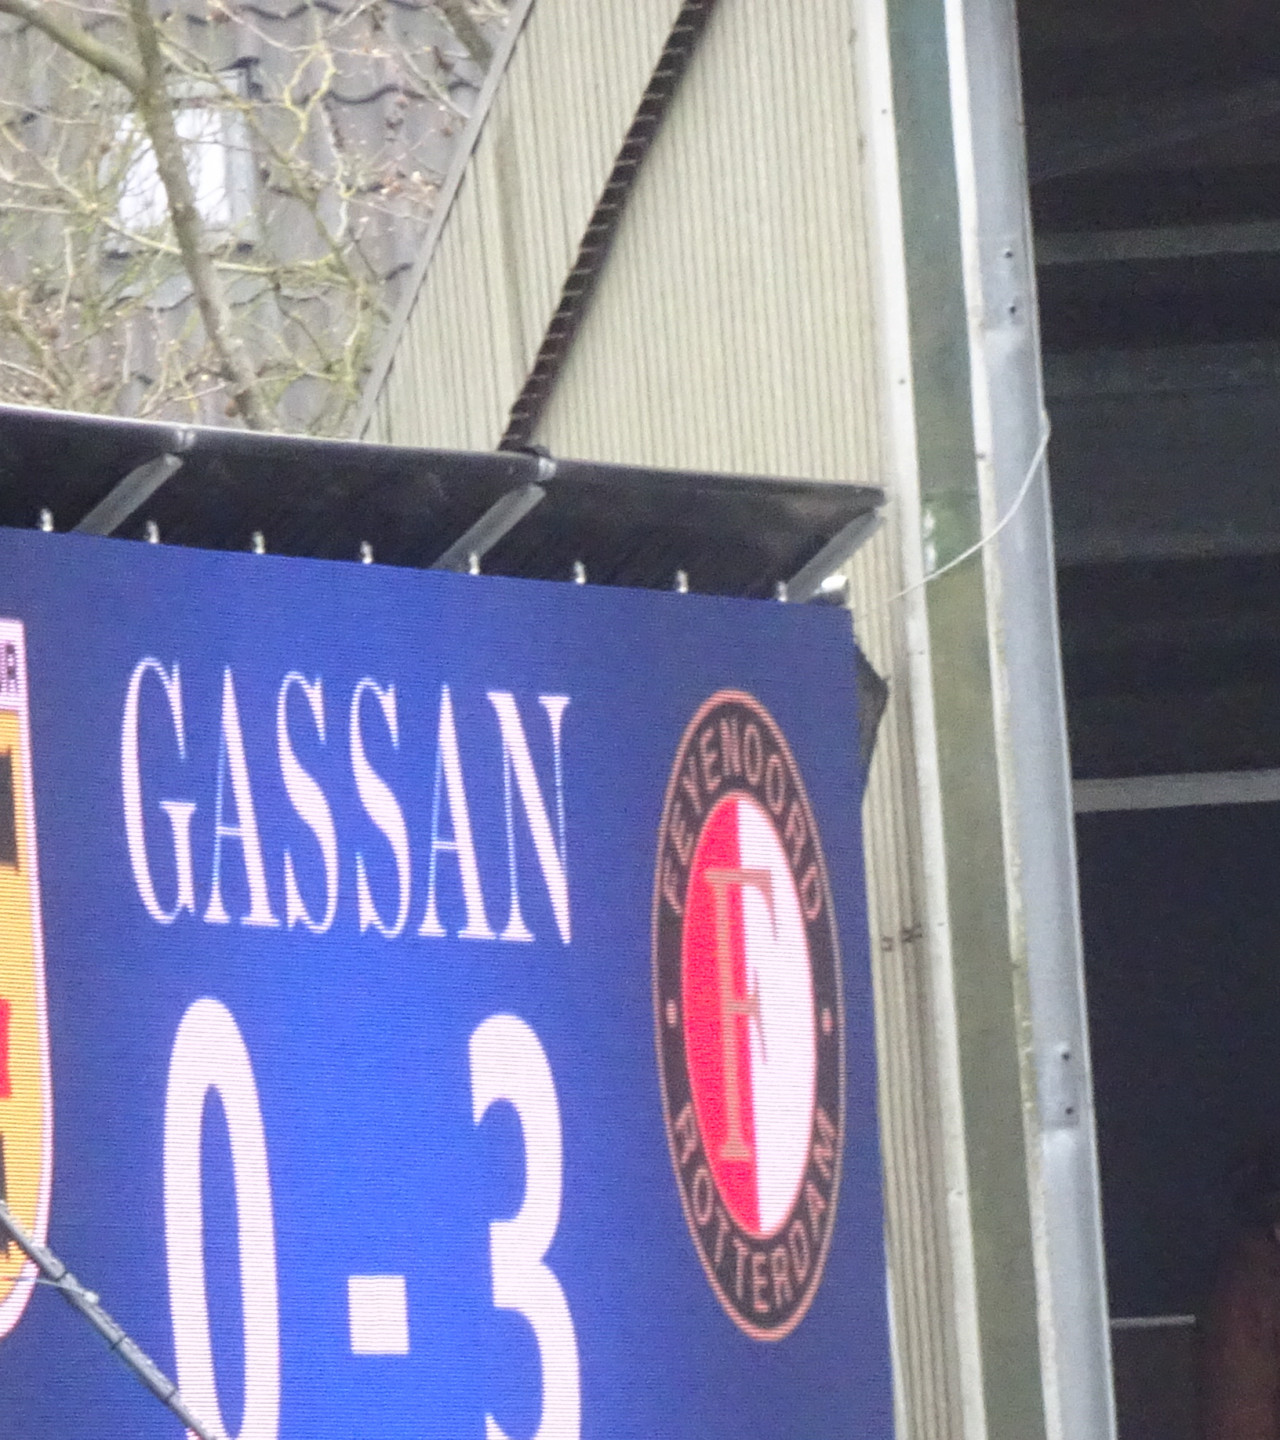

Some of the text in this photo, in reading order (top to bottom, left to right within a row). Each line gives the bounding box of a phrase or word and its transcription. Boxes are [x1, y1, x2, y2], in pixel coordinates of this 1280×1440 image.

[122, 656, 572, 943] GASSAN
[664, 716, 821, 921] FEYENOORD
[673, 1100, 838, 1313] ROTTERDAM
[347, 1273, 410, 1355] -
